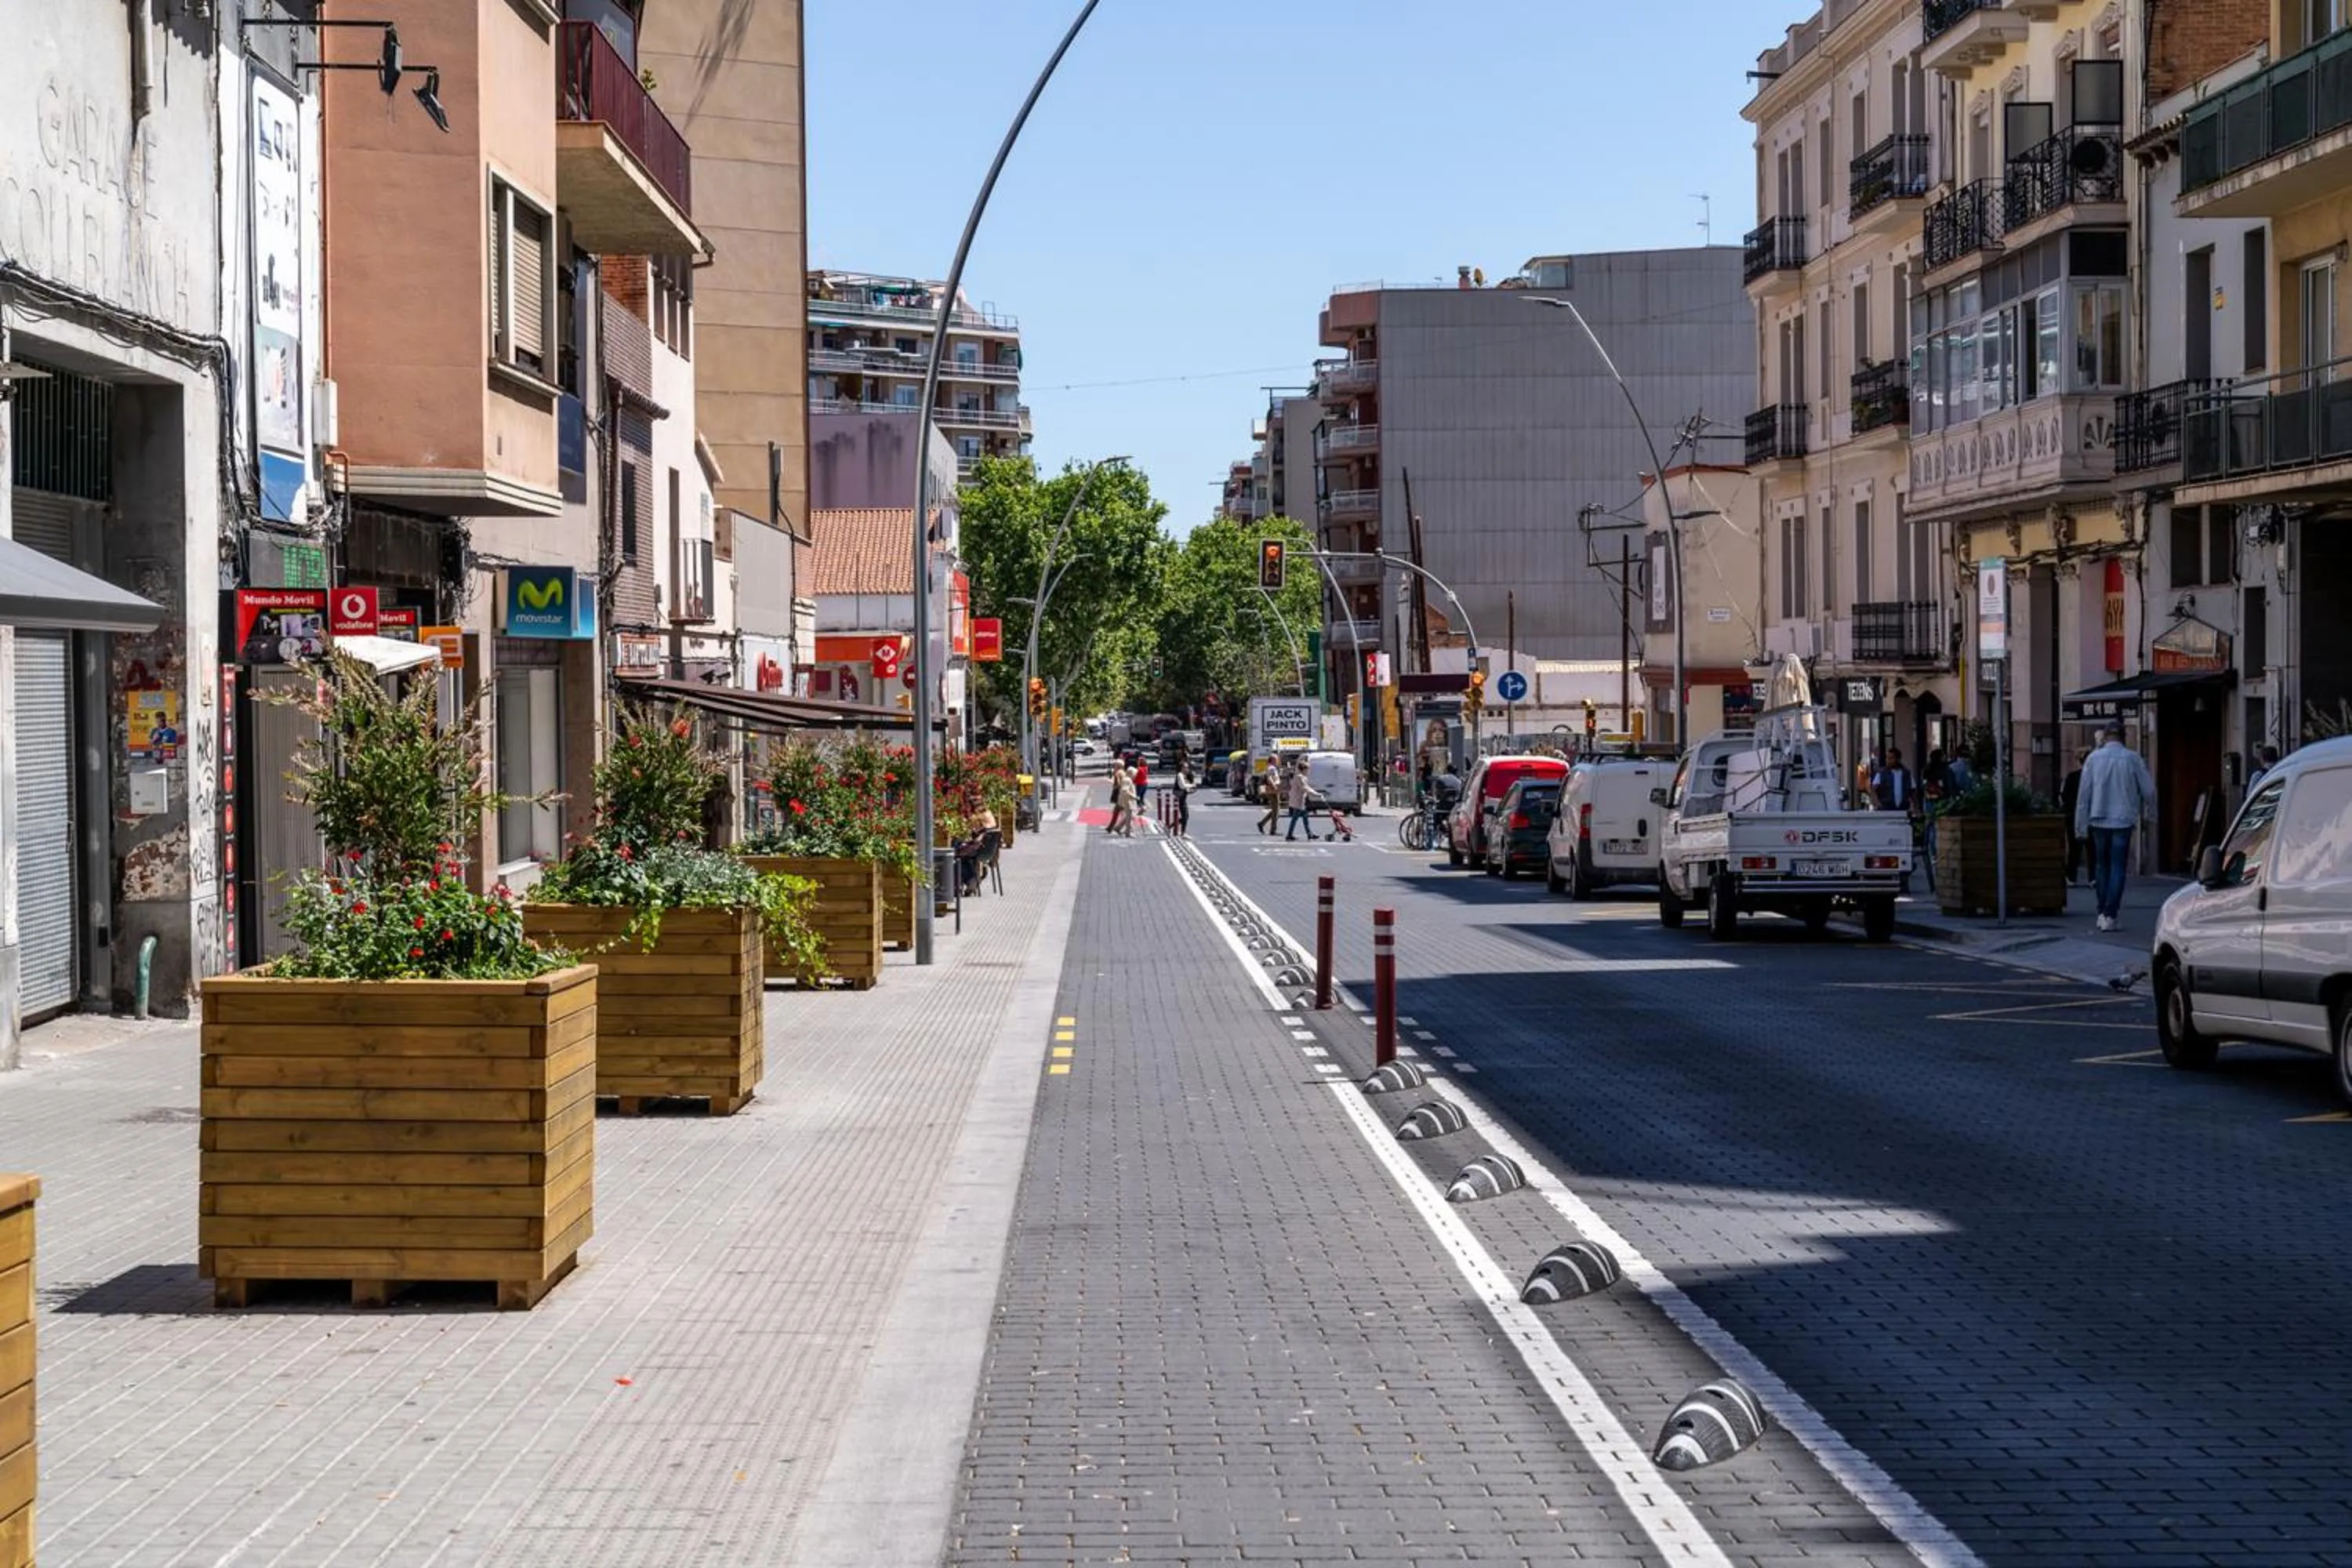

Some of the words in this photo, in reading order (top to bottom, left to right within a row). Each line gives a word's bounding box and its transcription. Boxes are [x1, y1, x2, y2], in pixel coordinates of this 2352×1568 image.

[244, 594, 282, 605] Mundo
[284, 594, 314, 605] Movil
[515, 614, 564, 624] movistar
[335, 620, 375, 630] vodafone
[1270, 709, 1302, 719] JACK
[1266, 720, 1306, 729] PINTO
[1802, 831, 1858, 843] DFSK
